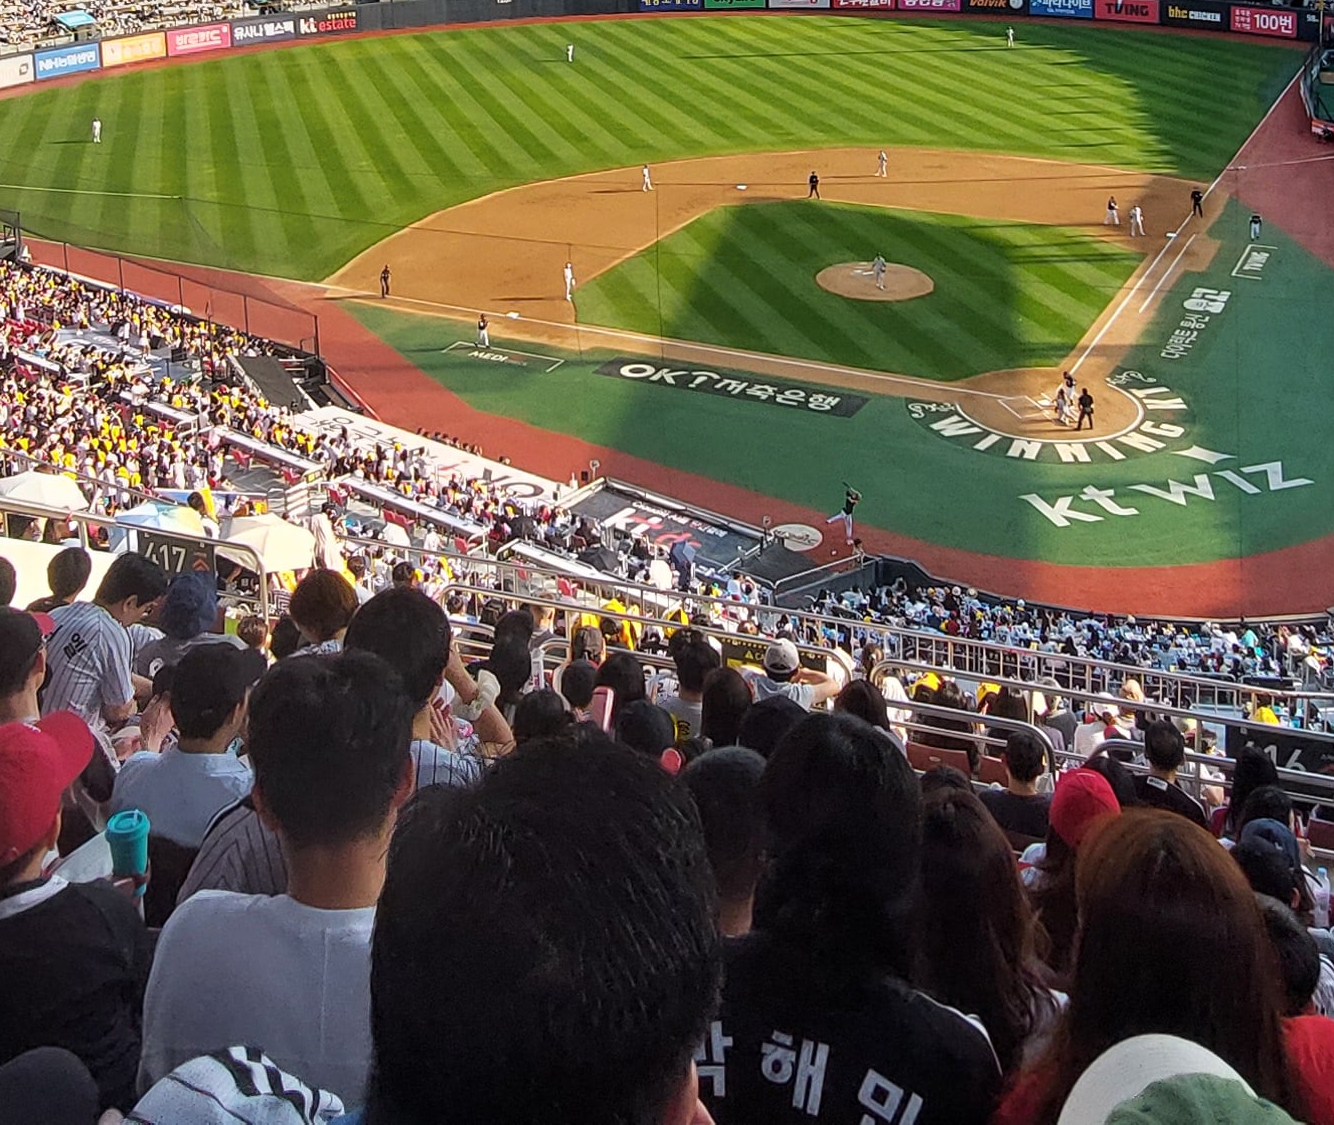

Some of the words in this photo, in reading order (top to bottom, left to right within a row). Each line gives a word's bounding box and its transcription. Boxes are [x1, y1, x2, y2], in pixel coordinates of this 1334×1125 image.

[300, 18, 318, 35] kt
[319, 19, 356, 32] estate
[1168, 6, 1188, 19] bhc
[1189, 10, 1221, 22] CHICKEN
[1254, 14, 1293, 34] 100번
[619, 363, 690, 385] OK
[714, 377, 842, 412] 저축은행
[929, 413, 1187, 463] WINNING
[1130, 386, 1189, 412] KT
[1017, 484, 1140, 528] kt
[1126, 457, 1316, 507] wiz
